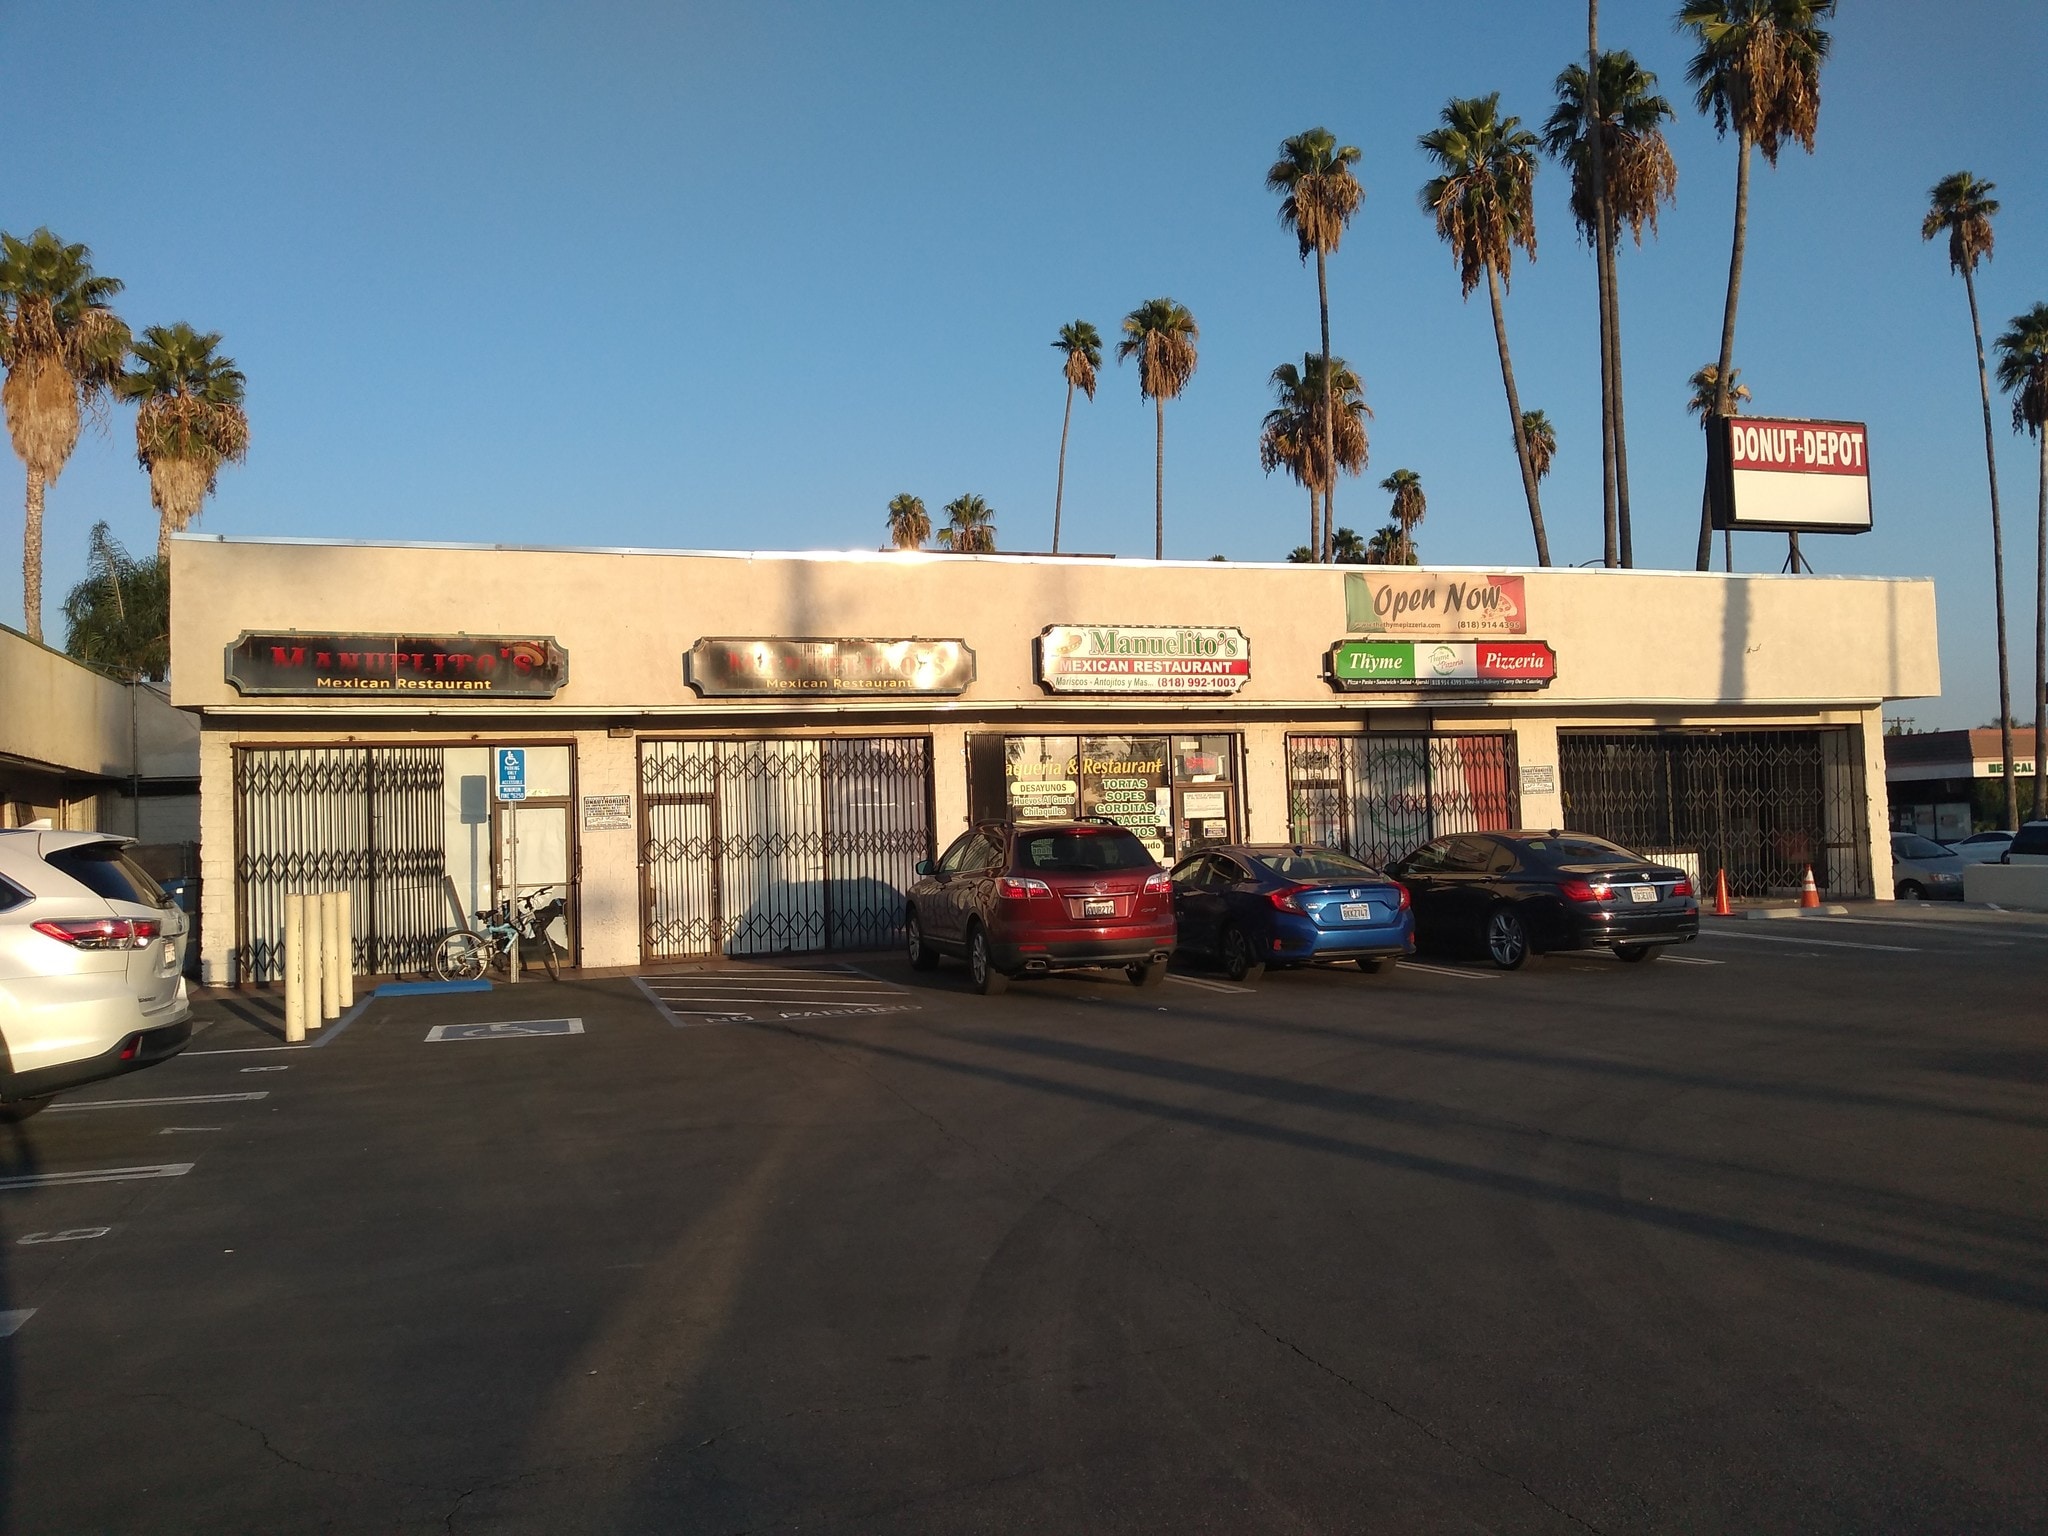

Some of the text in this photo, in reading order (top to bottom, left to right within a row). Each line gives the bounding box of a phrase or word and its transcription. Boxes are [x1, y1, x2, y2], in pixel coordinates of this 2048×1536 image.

[1733, 426, 1863, 467] DONUT DEPOT
[1373, 582, 1501, 622] Open Now
[1457, 621, 1480, 629] (818)
[1481, 621, 1497, 629] 914
[1089, 629, 1239, 657] Manuelito's
[1060, 660, 1233, 674] MEXICAN RESTAURANT
[1350, 651, 1545, 673] Thyme Pizzeria
[317, 677, 492, 690] Mexican Restaurant
[766, 678, 913, 689] Mexican Restaurant
[1056, 677, 1088, 686] Mariscos
[1094, 677, 1127, 688] Antojitos
[1157, 677, 1237, 688] (818) 992-1003
[1006, 759, 1062, 781] aqueria
[1083, 758, 1162, 774] Restaurant
[1988, 763, 2034, 774] MECAL
[1020, 783, 1067, 792] DESAYUNOS
[1103, 780, 1147, 788] TORTAS
[1052, 795, 1075, 804] Gusto
[1107, 792, 1145, 800] SOPES
[1023, 806, 1067, 818] Chilaquiles
[1096, 803, 1155, 813] GORDITAS
[705, 1015, 754, 1023] NO
